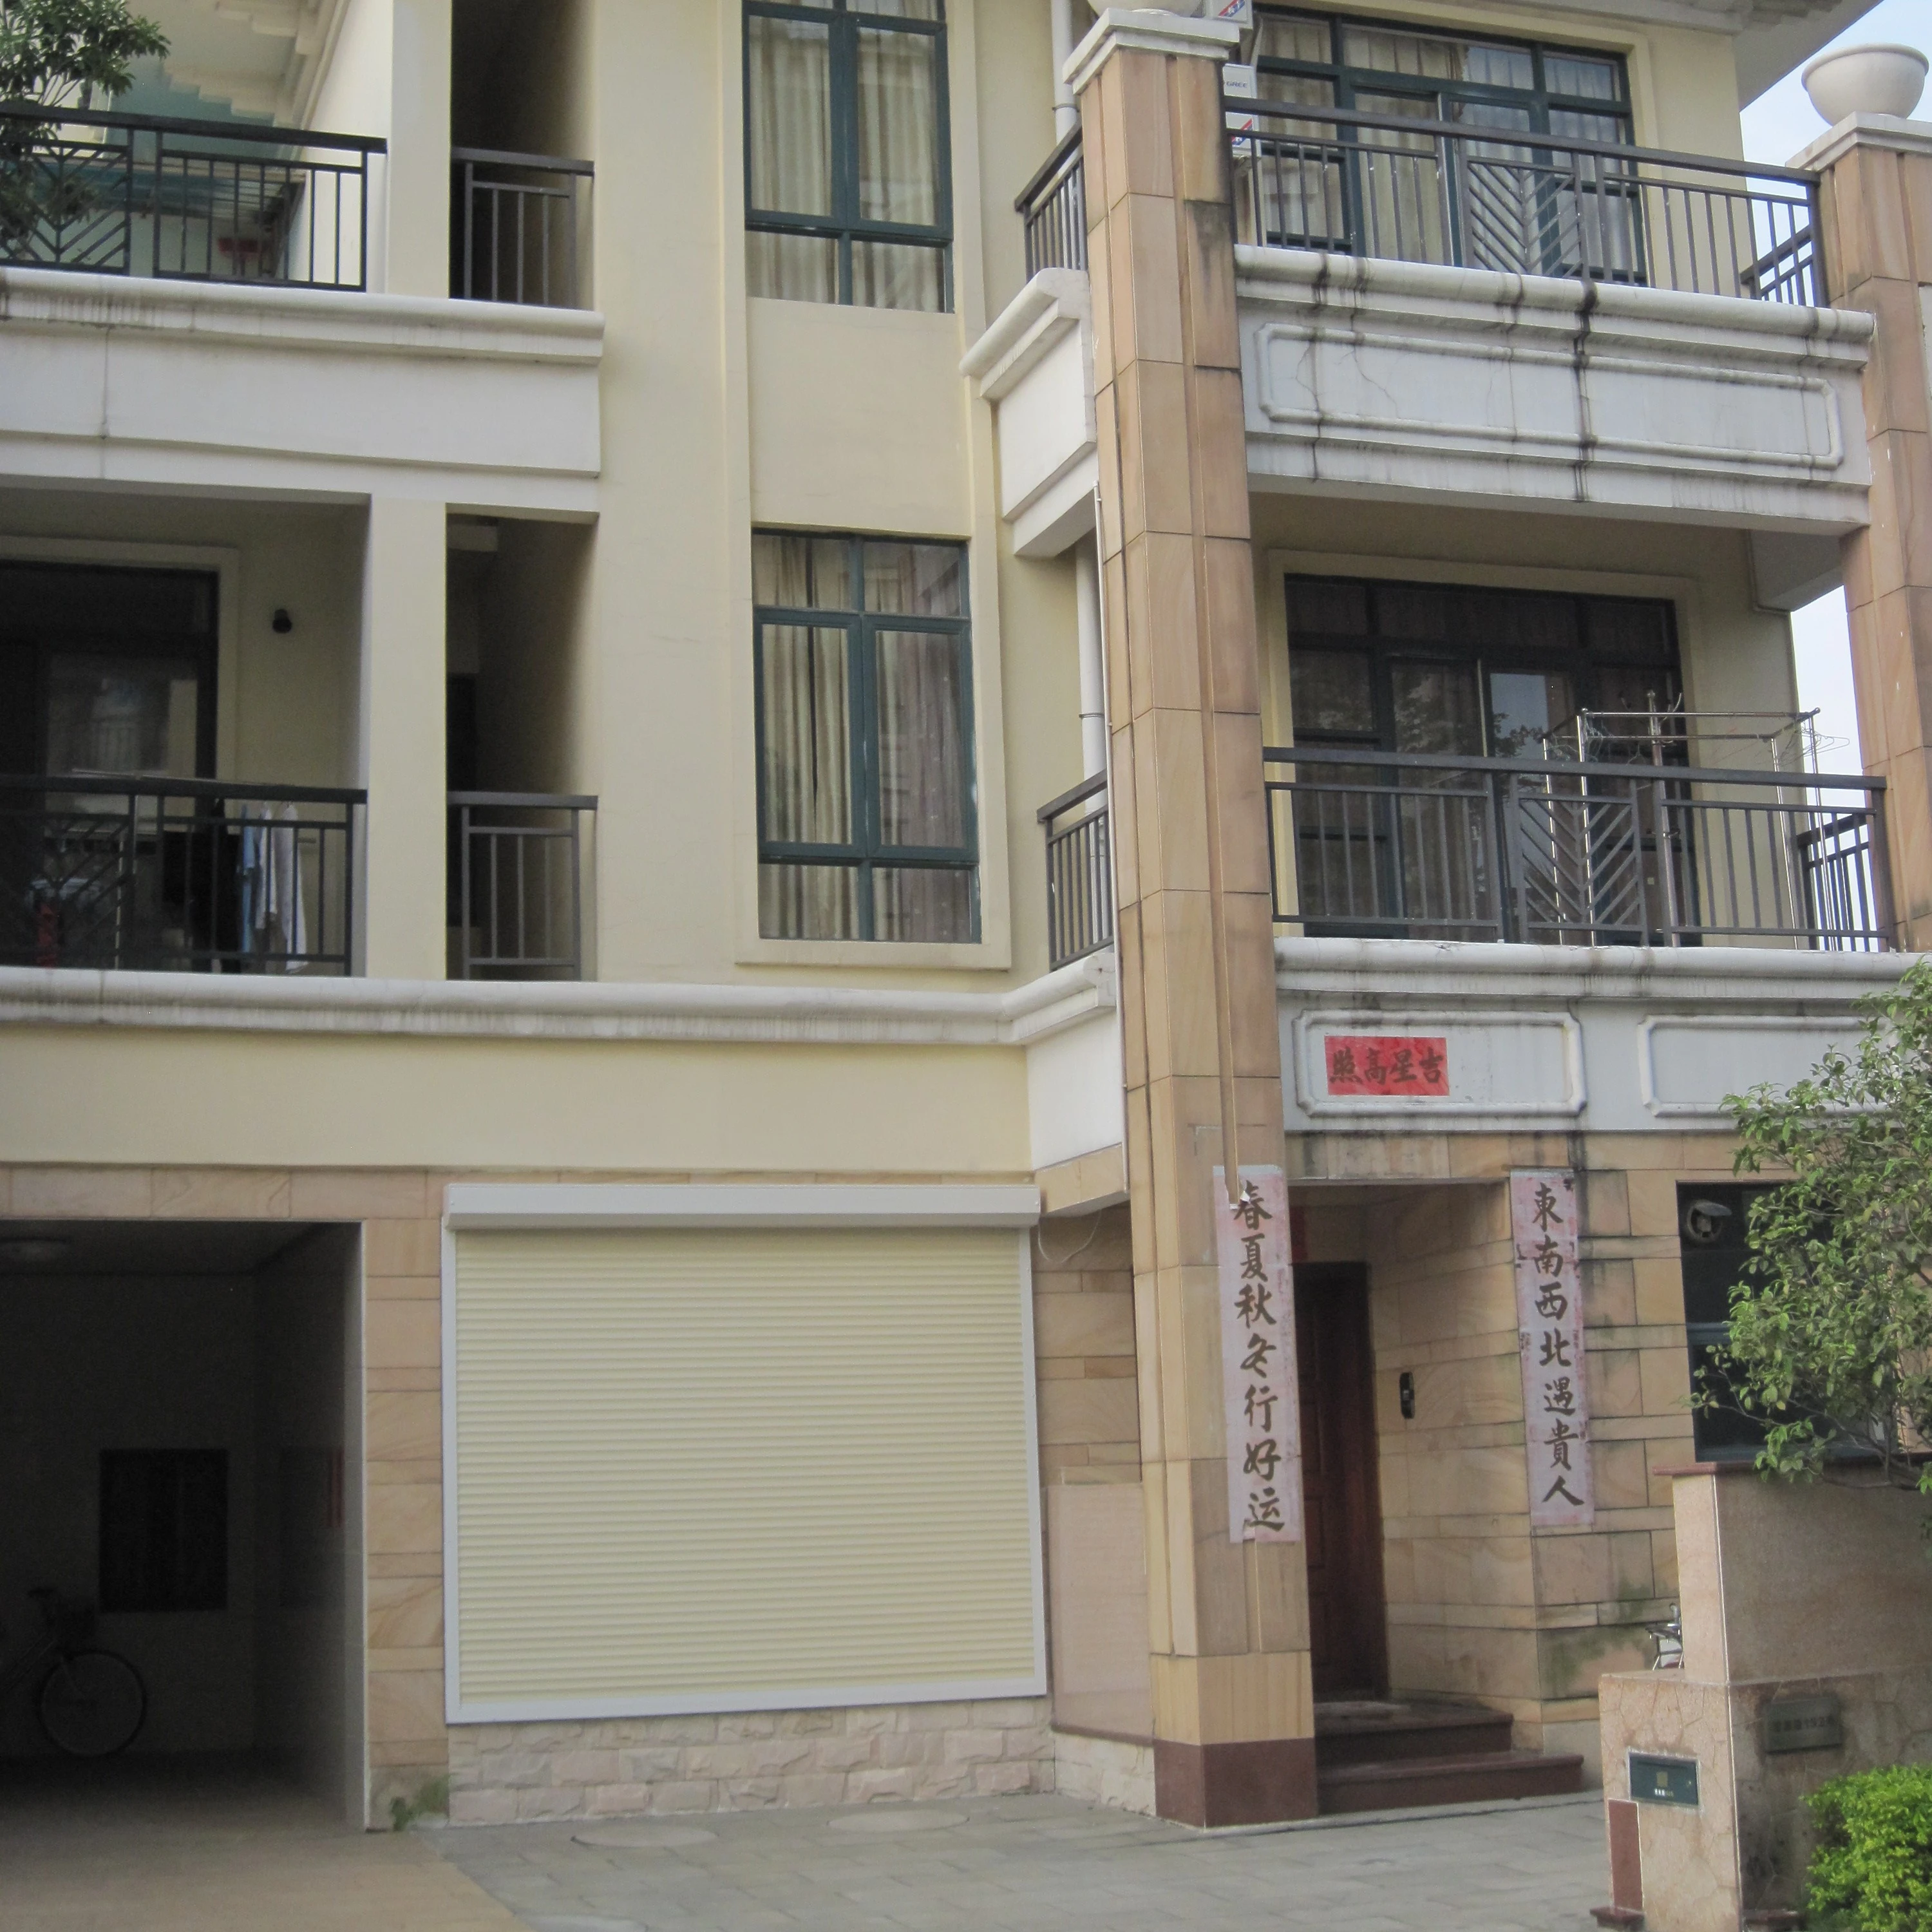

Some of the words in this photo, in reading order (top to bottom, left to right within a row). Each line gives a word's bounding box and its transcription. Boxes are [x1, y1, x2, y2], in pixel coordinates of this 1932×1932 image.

[1233, 1179, 1285, 1532] 春夏秋冬行好运
[1532, 1182, 1585, 1507] 東南西北遇貴人
